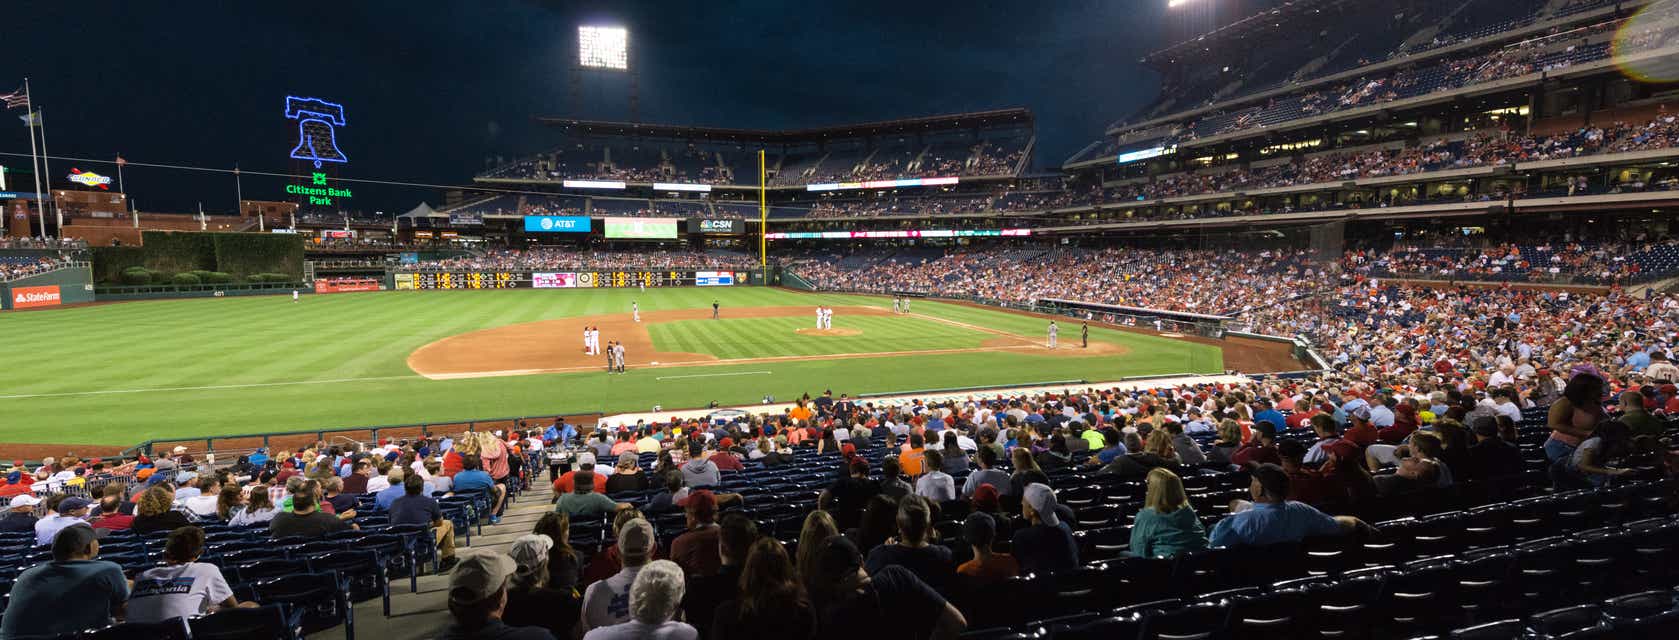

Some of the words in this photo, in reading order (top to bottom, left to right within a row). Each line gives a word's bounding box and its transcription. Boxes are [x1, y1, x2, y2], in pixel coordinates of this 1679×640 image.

[72, 175, 110, 183] SUNOCO
[286, 185, 326, 195] Citizens
[328, 188, 352, 197] Bank
[310, 196, 331, 205] Park
[554, 220, 576, 228] AT&T
[713, 220, 732, 228] CSN
